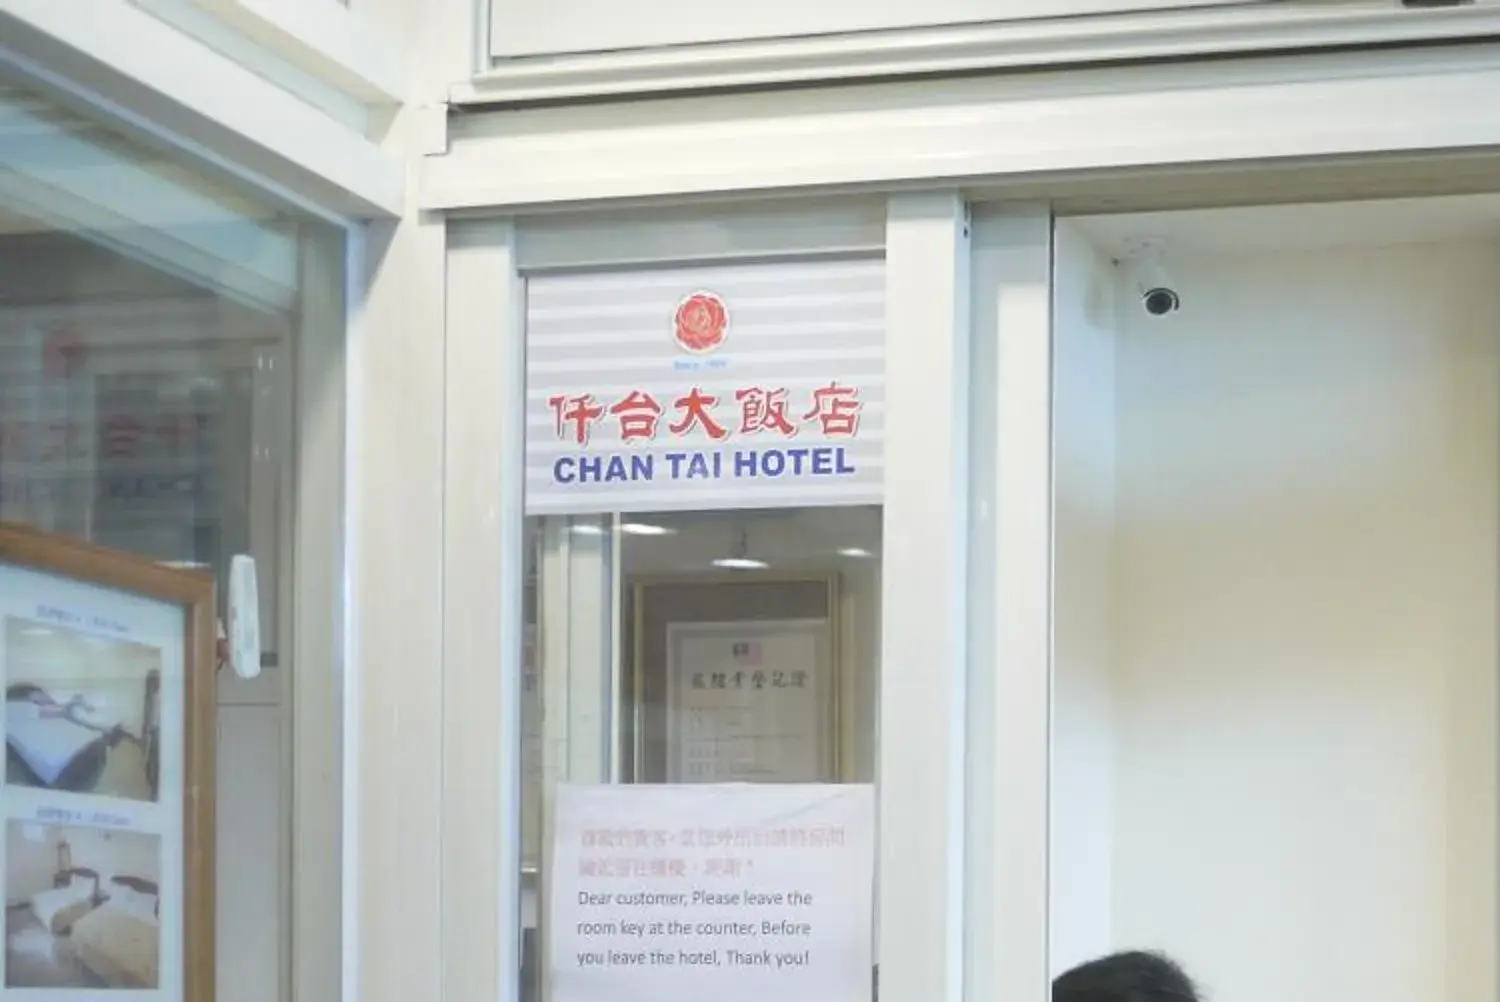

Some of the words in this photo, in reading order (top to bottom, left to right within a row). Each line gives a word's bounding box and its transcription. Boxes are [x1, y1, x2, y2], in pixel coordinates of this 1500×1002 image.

[549, 380, 863, 446] 仟台大飯店
[554, 455, 654, 484] CHAN
[665, 452, 721, 480] TAI
[733, 447, 855, 478] HOTEL
[578, 891, 613, 905] Dear
[616, 892, 688, 907] customer,
[692, 890, 741, 905] Please
[744, 889, 784, 905] leave
[787, 889, 813, 905] the
[577, 922, 617, 935] room
[621, 919, 645, 938] key
[649, 921, 665, 935] at
[668, 920, 692, 935] the
[761, 919, 812, 935] Before
[577, 951, 604, 967] you
[608, 949, 646, 965] leave
[650, 950, 675, 965] the
[679, 949, 721, 967] hotel,
[726, 949, 771, 965] Thank
[775, 950, 809, 968] you!
